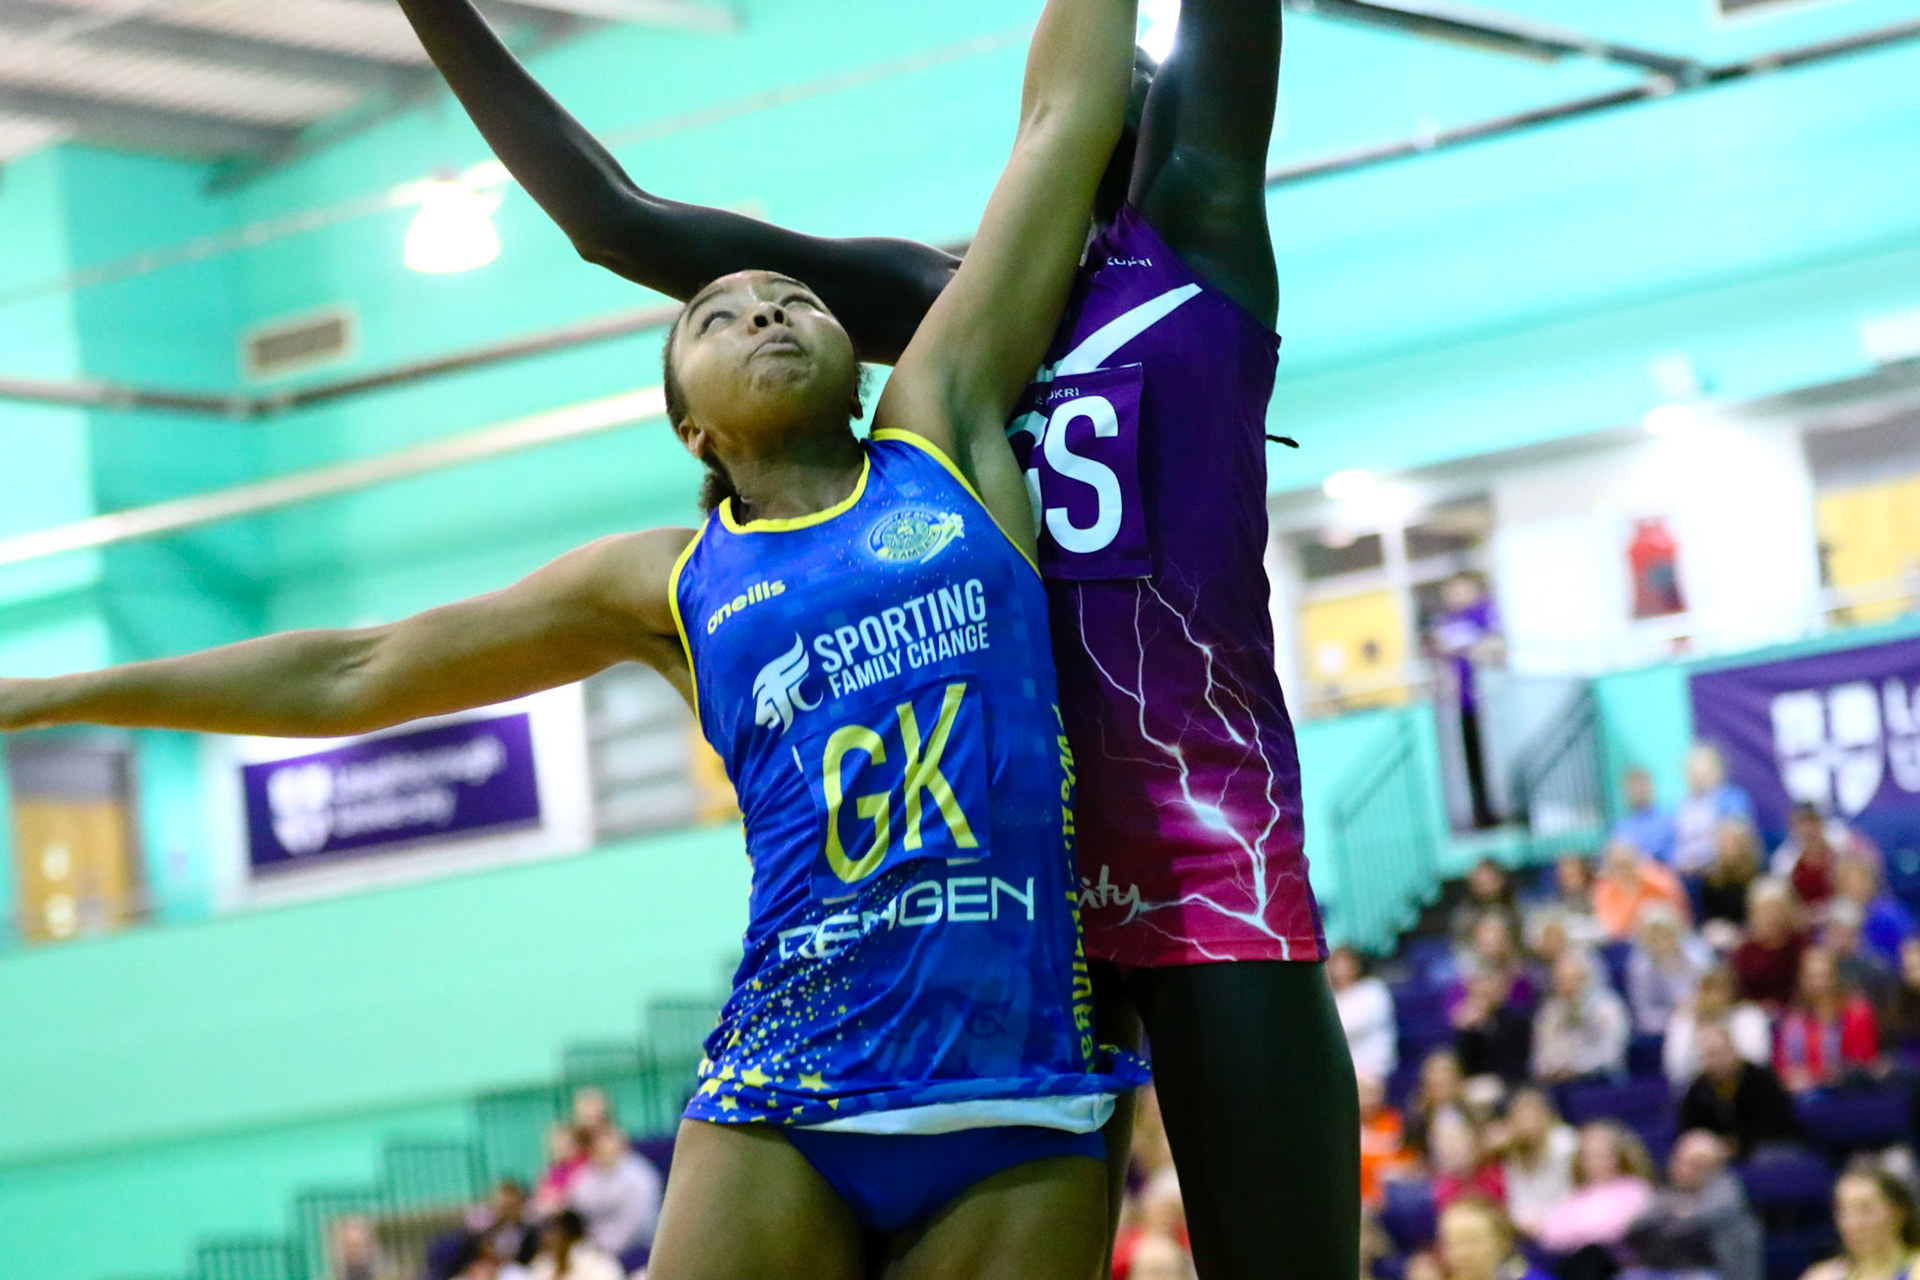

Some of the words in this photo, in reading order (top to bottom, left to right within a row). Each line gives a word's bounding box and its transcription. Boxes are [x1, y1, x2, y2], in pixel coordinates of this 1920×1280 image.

[813, 578, 986, 673] SPORTING
[828, 648, 901, 699] FAMILY
[906, 622, 990, 669] CHANGE
[822, 682, 980, 884] GK
[1078, 864, 1142, 926] ity
